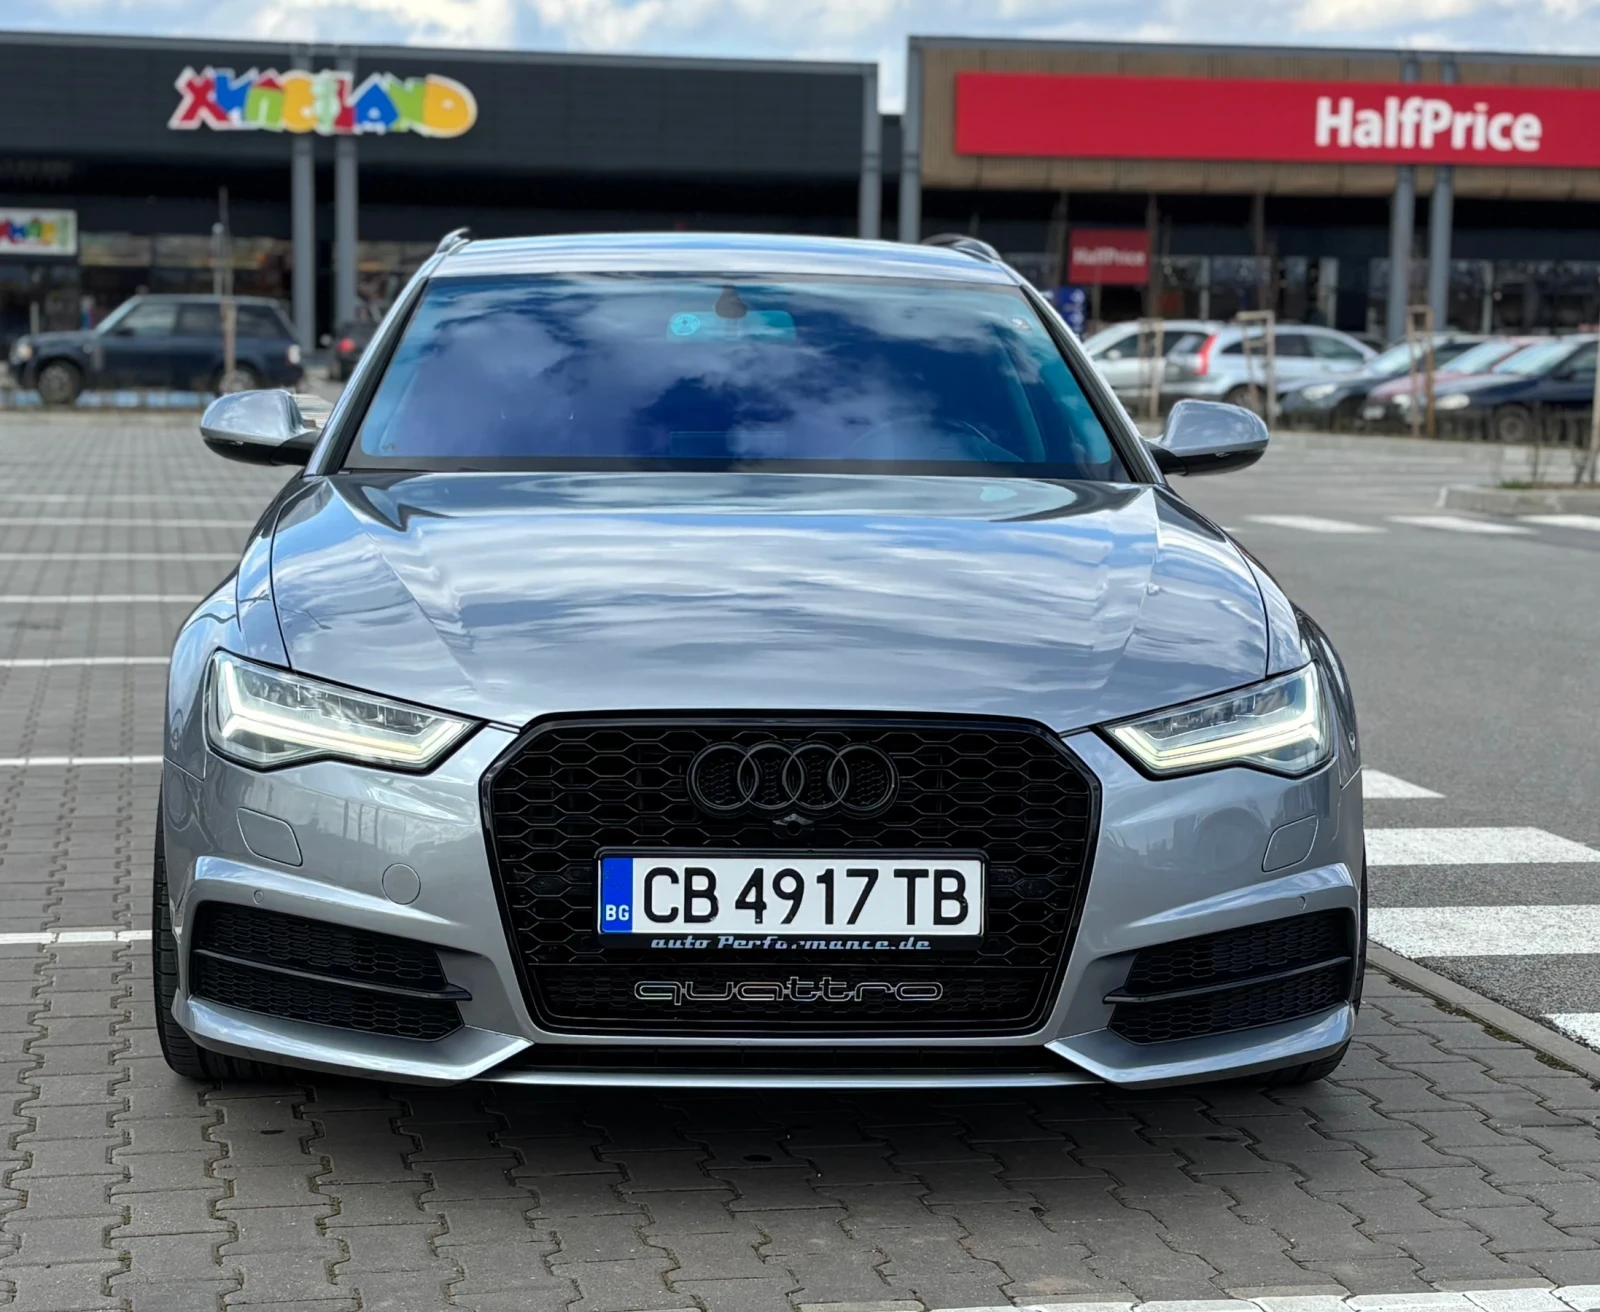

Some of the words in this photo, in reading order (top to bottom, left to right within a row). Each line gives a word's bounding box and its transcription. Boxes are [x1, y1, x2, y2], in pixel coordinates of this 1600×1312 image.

[1315, 96, 1543, 151] HalfPrice
[1071, 246, 1146, 267] HalfPrice
[644, 866, 719, 923] CB
[735, 867, 879, 925] 4917
[893, 868, 969, 926] TB
[605, 904, 629, 921] BG
[651, 935, 712, 949] auto
[633, 976, 944, 1006] quattro
